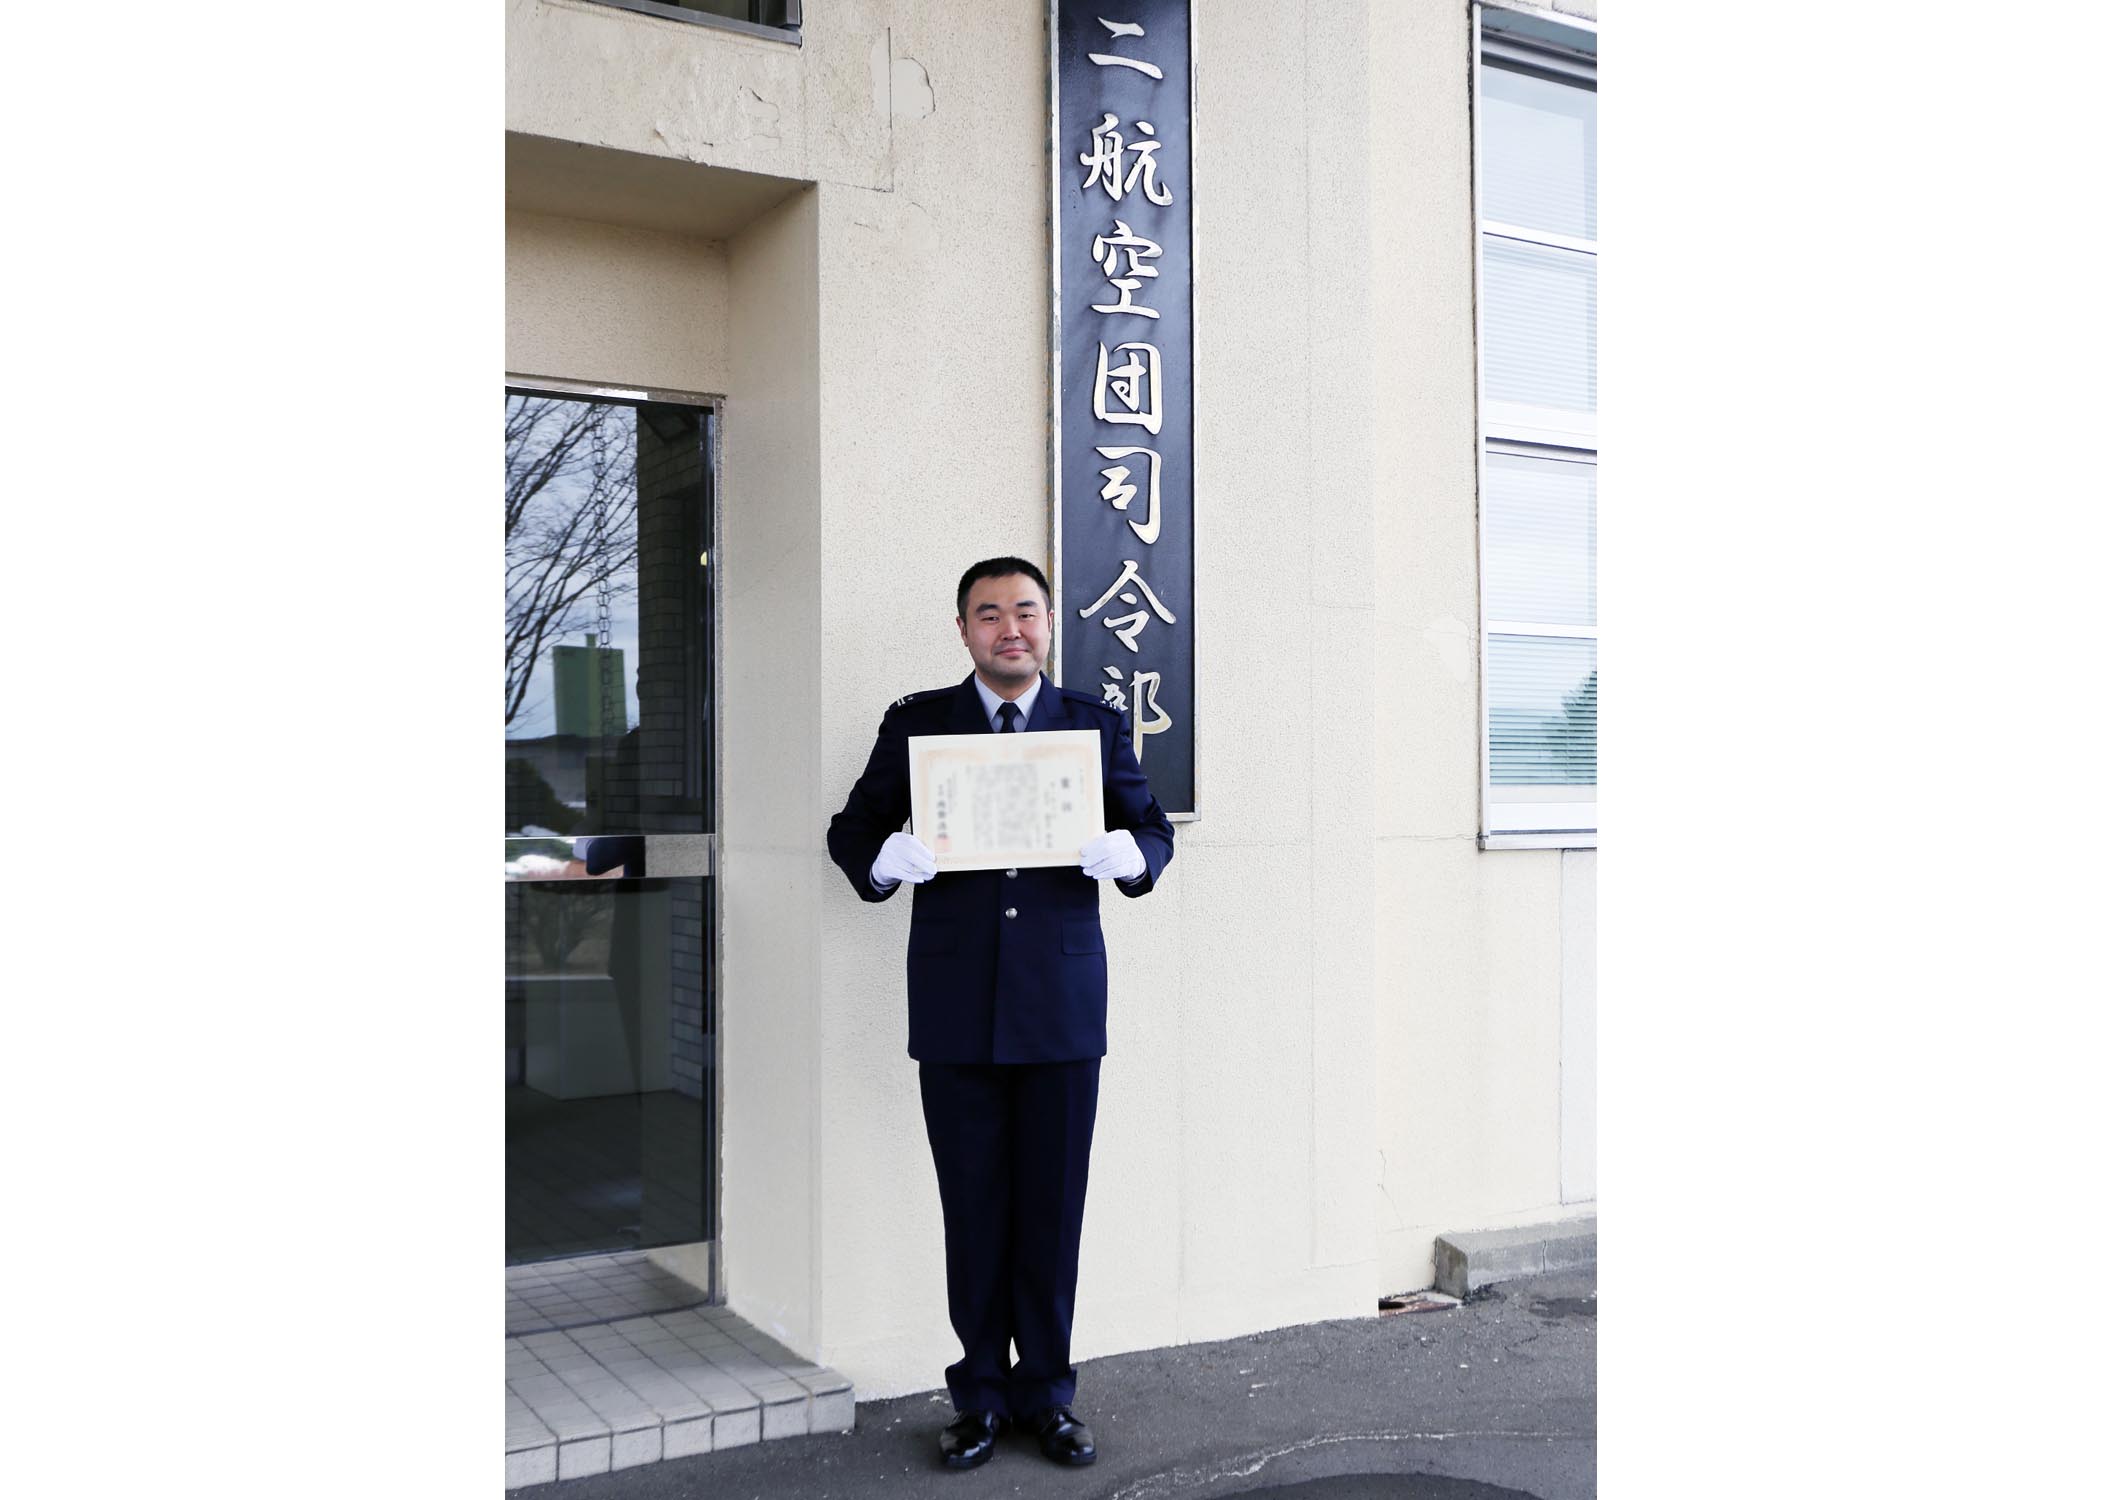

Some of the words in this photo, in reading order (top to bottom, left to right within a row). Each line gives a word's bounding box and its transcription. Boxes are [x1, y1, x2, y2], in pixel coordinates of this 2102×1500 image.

[1079, 16, 1177, 766] 二航空団司令部
